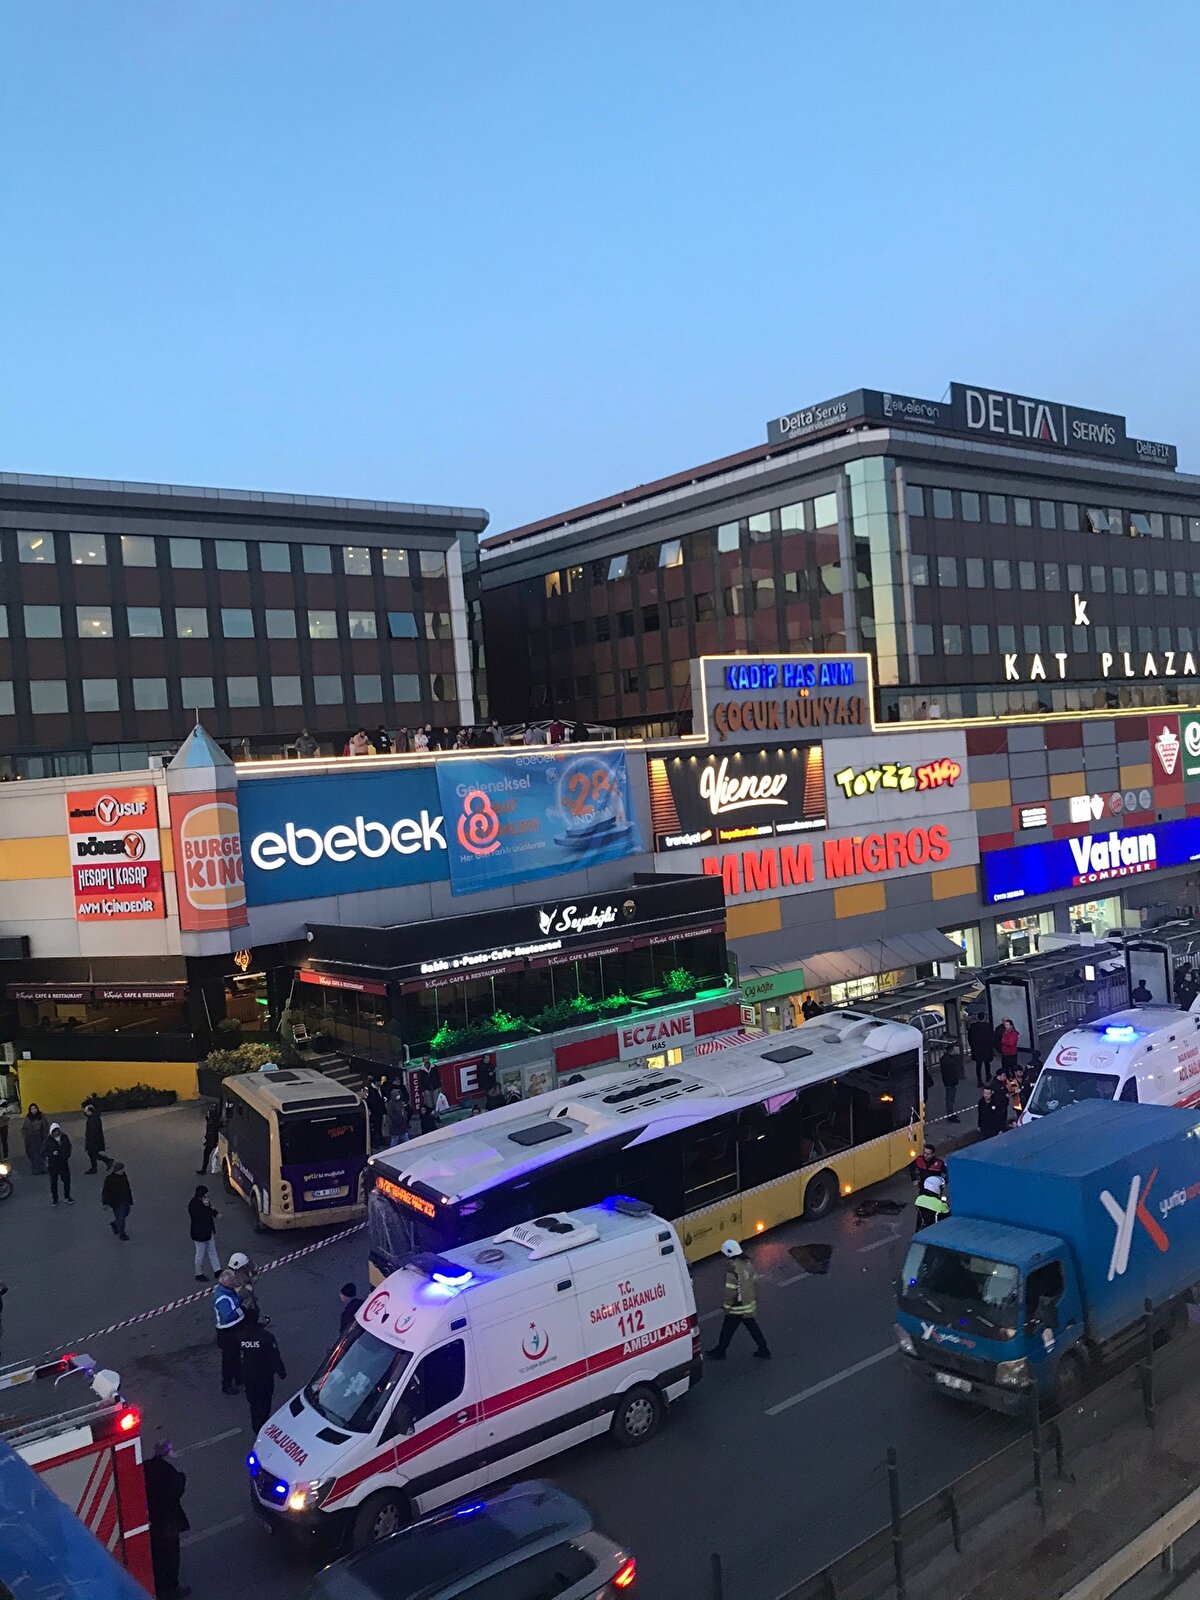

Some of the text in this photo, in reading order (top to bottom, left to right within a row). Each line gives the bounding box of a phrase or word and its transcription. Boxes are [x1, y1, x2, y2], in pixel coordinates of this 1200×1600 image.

[780, 411, 813, 434] Delta
[966, 390, 1057, 443] DELTA
[783, 663, 817, 688] HAS
[820, 662, 854, 687] AVM
[1005, 651, 1196, 680] KAT PLAZA
[715, 689, 865, 742] ÇOCUK DÜNYASI
[250, 810, 448, 870] ebebek
[1069, 832, 1157, 875] Vatan
[79, 866, 147, 890] HESAPLI KASAP
[1079, 863, 1151, 884] COMPUTER
[79, 903, 101, 914] AVM
[744, 1009, 752, 1021] E
[623, 1016, 691, 1048] ECZANE
[652, 1041, 666, 1050] HAS
[460, 1064, 479, 1093] E
[618, 1281, 634, 1296] T.C.
[370, 1300, 385, 1315] 112
[590, 1283, 666, 1324] SAĞLIK BAKANLIĞI
[618, 1309, 645, 1337] 112
[623, 1319, 688, 1355] AMBULANS
